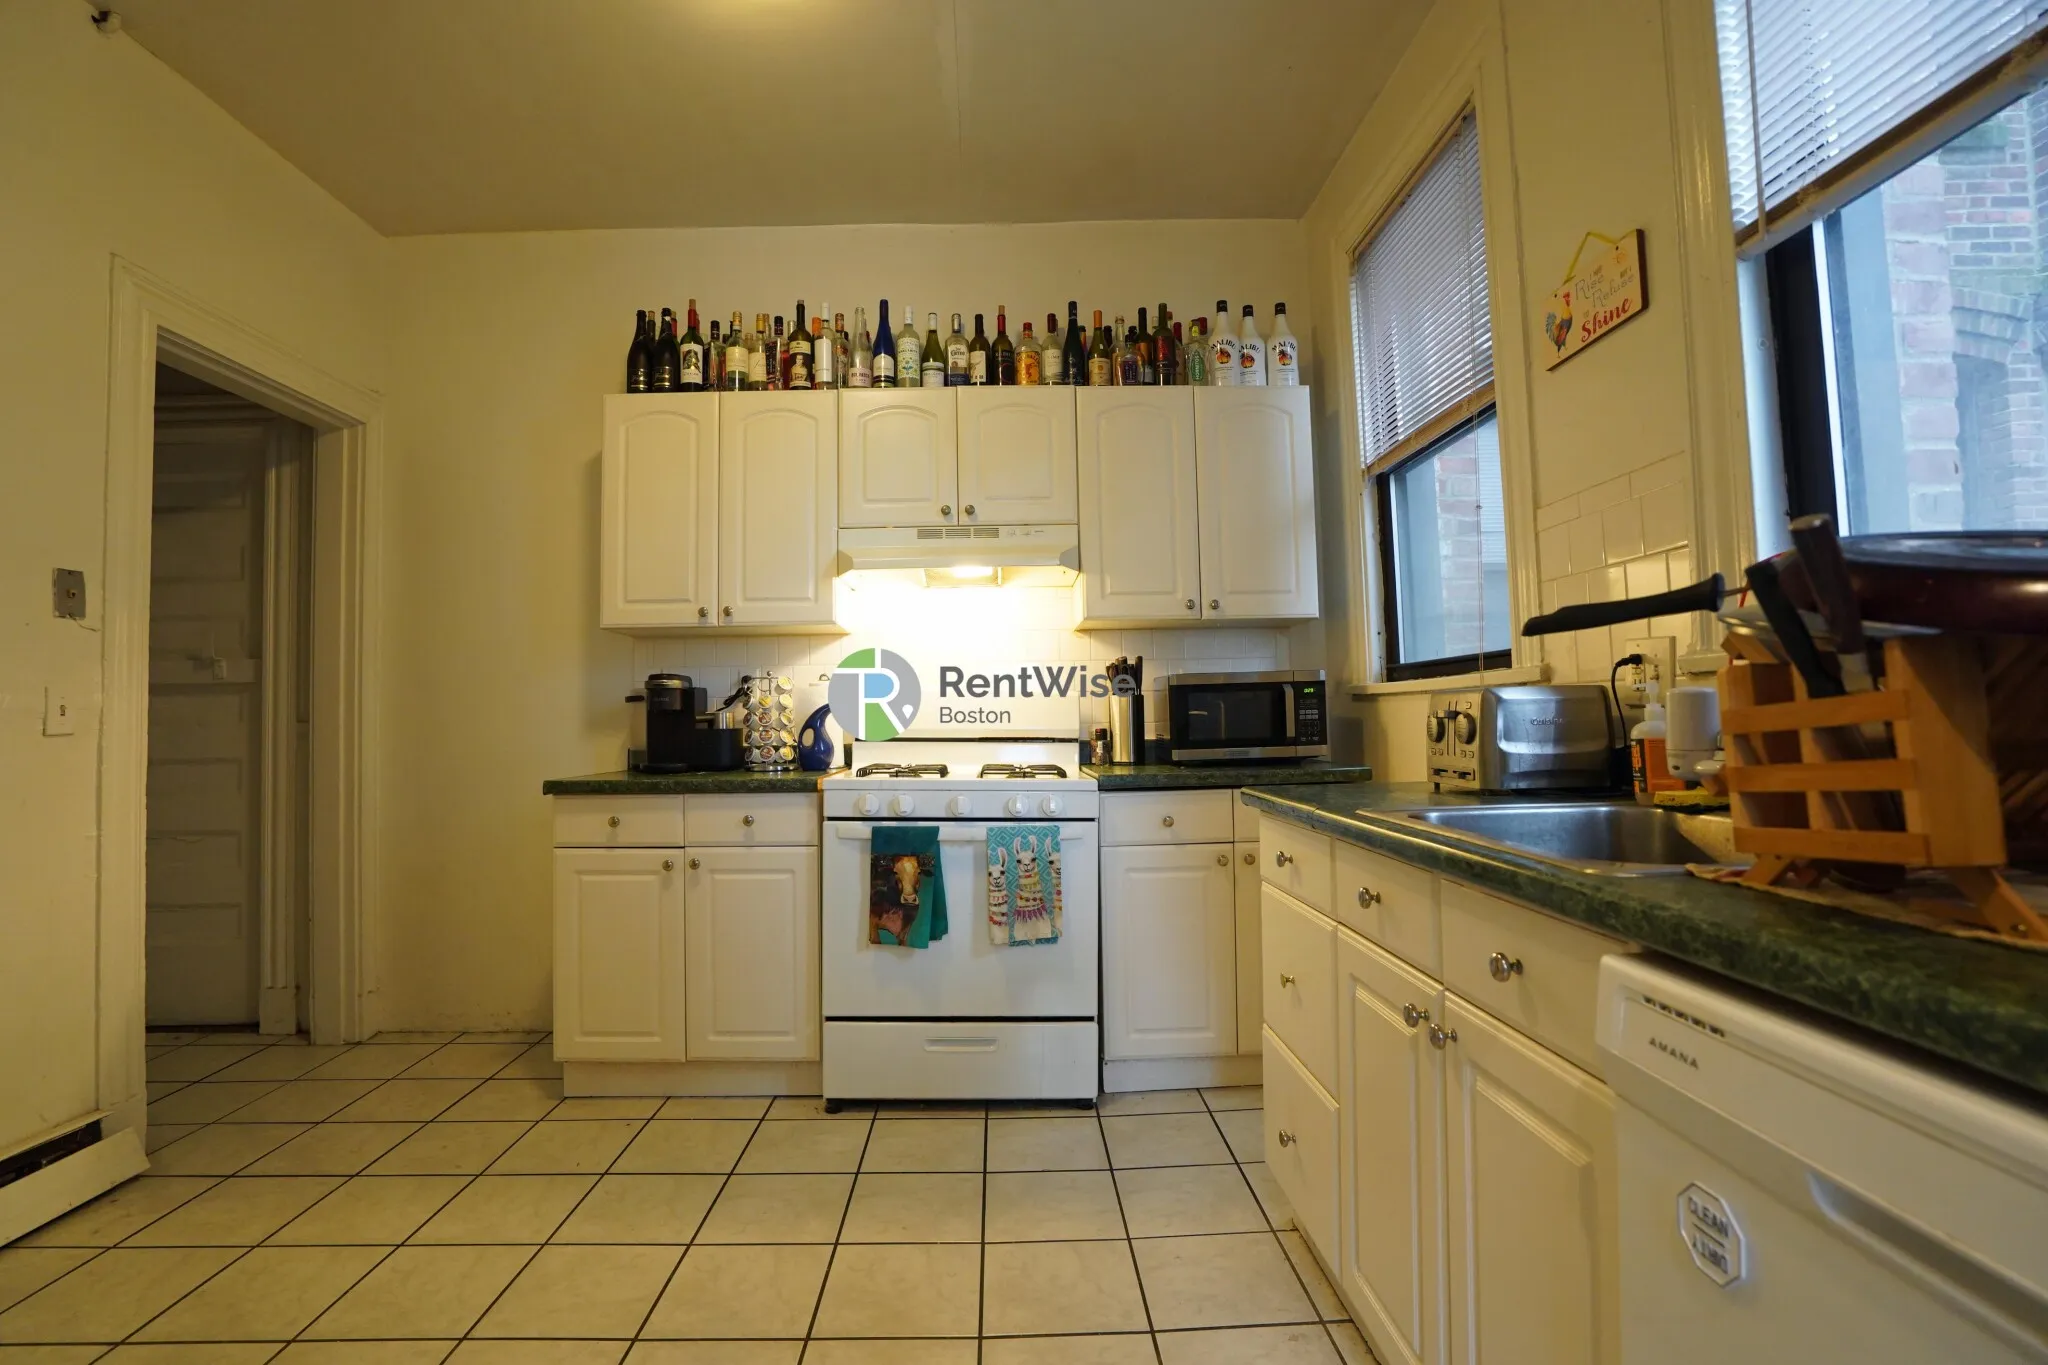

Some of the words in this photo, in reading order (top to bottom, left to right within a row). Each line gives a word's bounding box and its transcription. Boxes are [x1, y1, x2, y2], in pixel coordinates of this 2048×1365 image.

[1581, 297, 1632, 343] Shine
[1210, 339, 1237, 351] MALIBU
[1193, 355, 1201, 380] HORNITOS
[1648, 1037, 1700, 1070] AMANA
[1687, 1196, 1730, 1238] CLEAN
